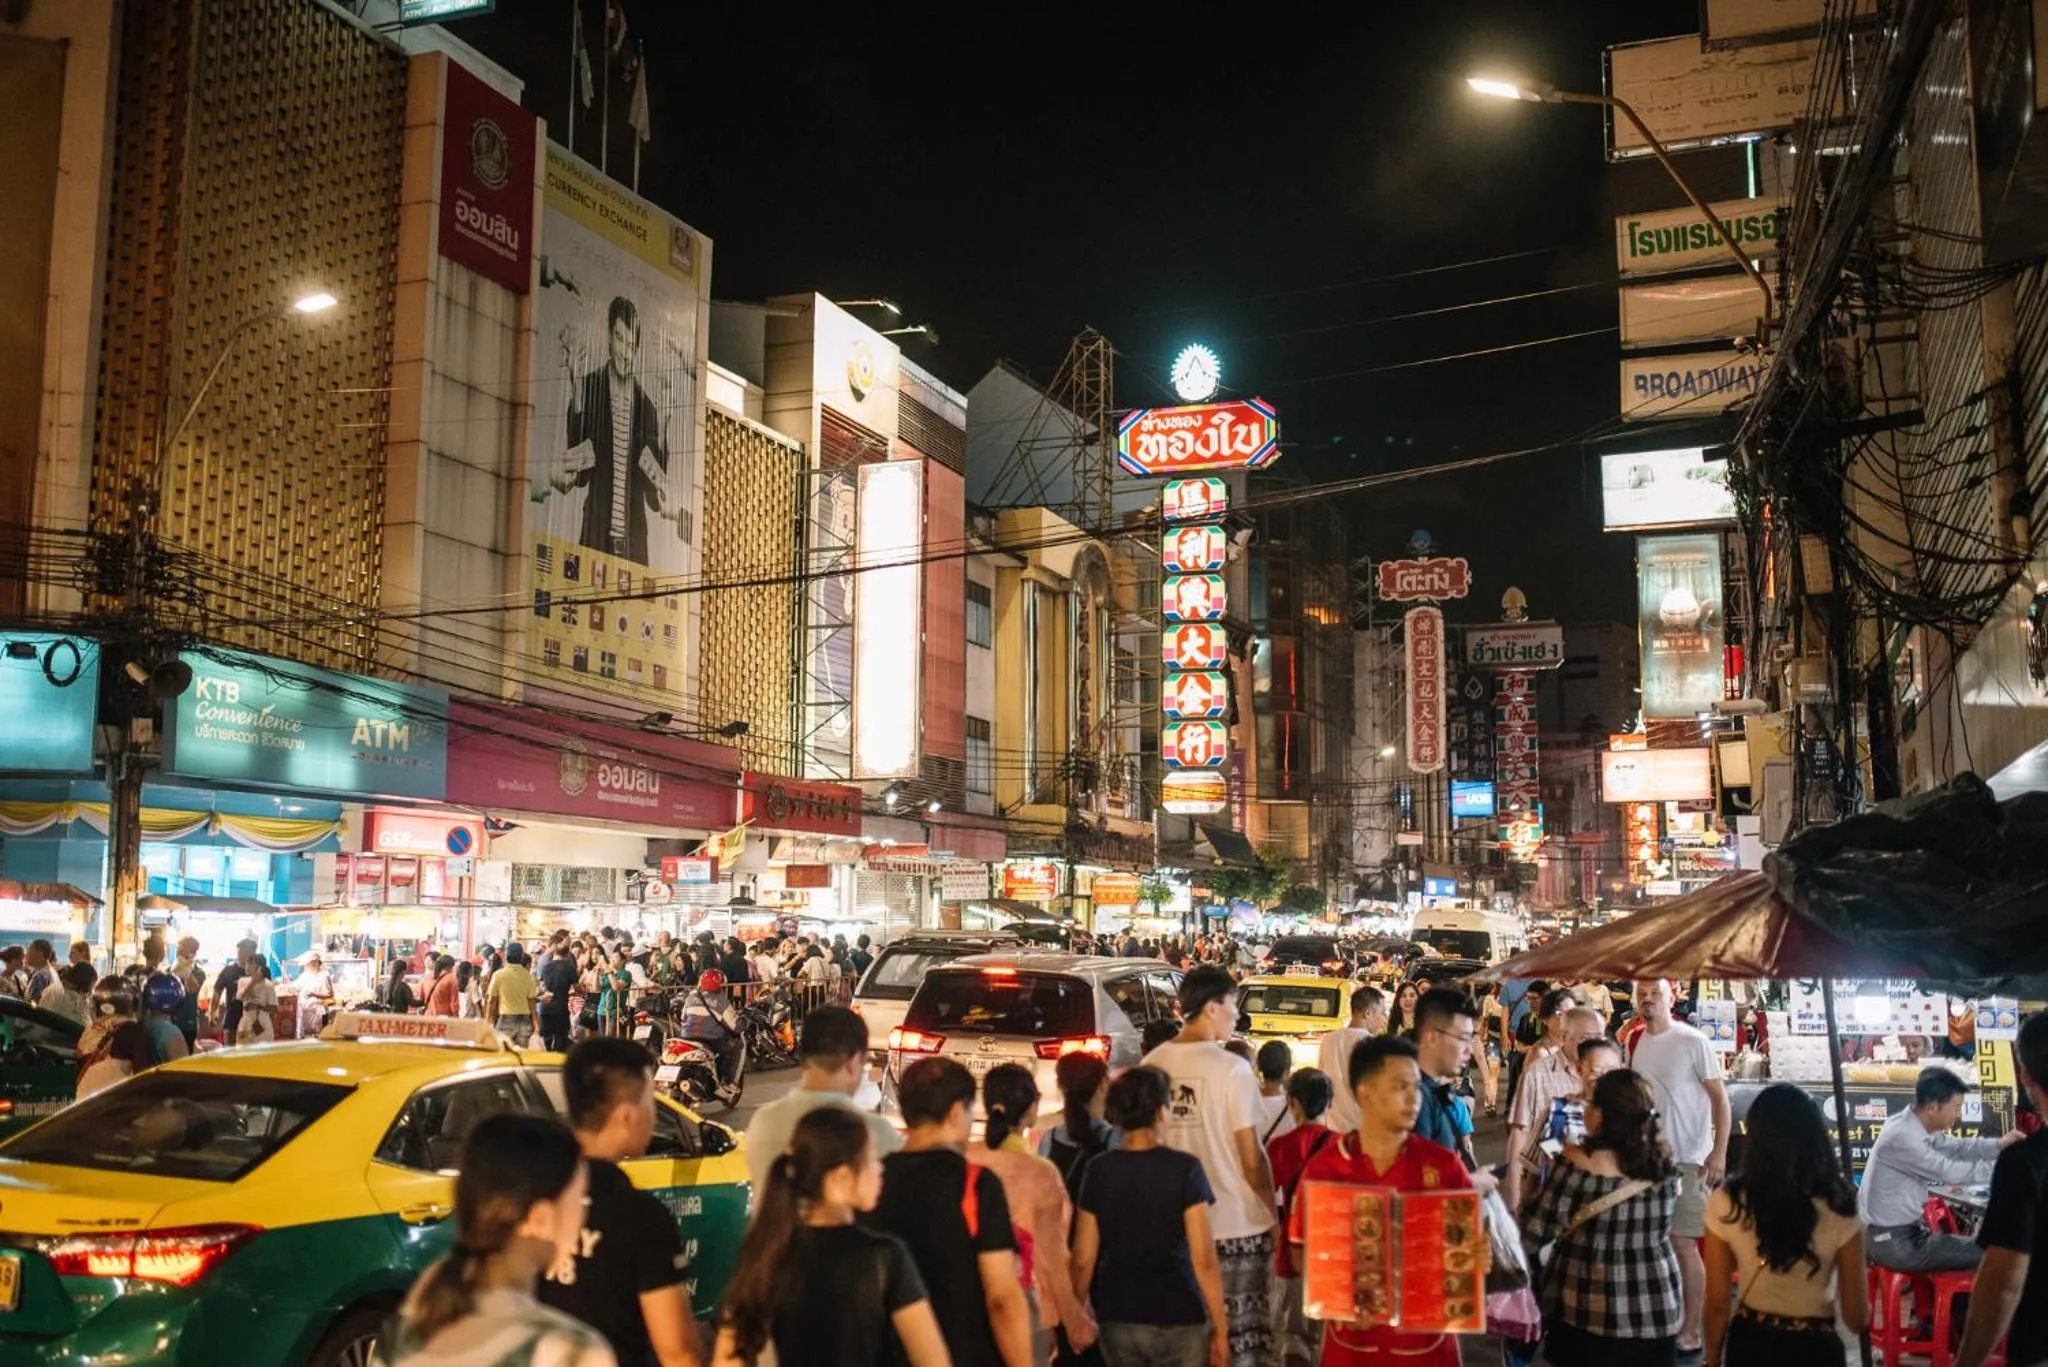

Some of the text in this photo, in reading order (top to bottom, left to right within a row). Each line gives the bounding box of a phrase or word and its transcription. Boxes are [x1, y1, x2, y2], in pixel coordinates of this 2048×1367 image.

[547, 172, 597, 212] CURRENCY
[599, 203, 648, 243] EXCHANGE
[455, 200, 519, 251] ออมสิน
[1634, 364, 1764, 399] BROADWAY
[1136, 412, 1261, 463] ทองใบ
[195, 676, 240, 704] KTB
[195, 701, 304, 733] Convenience
[351, 716, 409, 752] ATM
[597, 762, 661, 794] ออมสิน
[356, 1018, 448, 1038] TAXI-METER
[1964, 1101, 1981, 1115] 19
